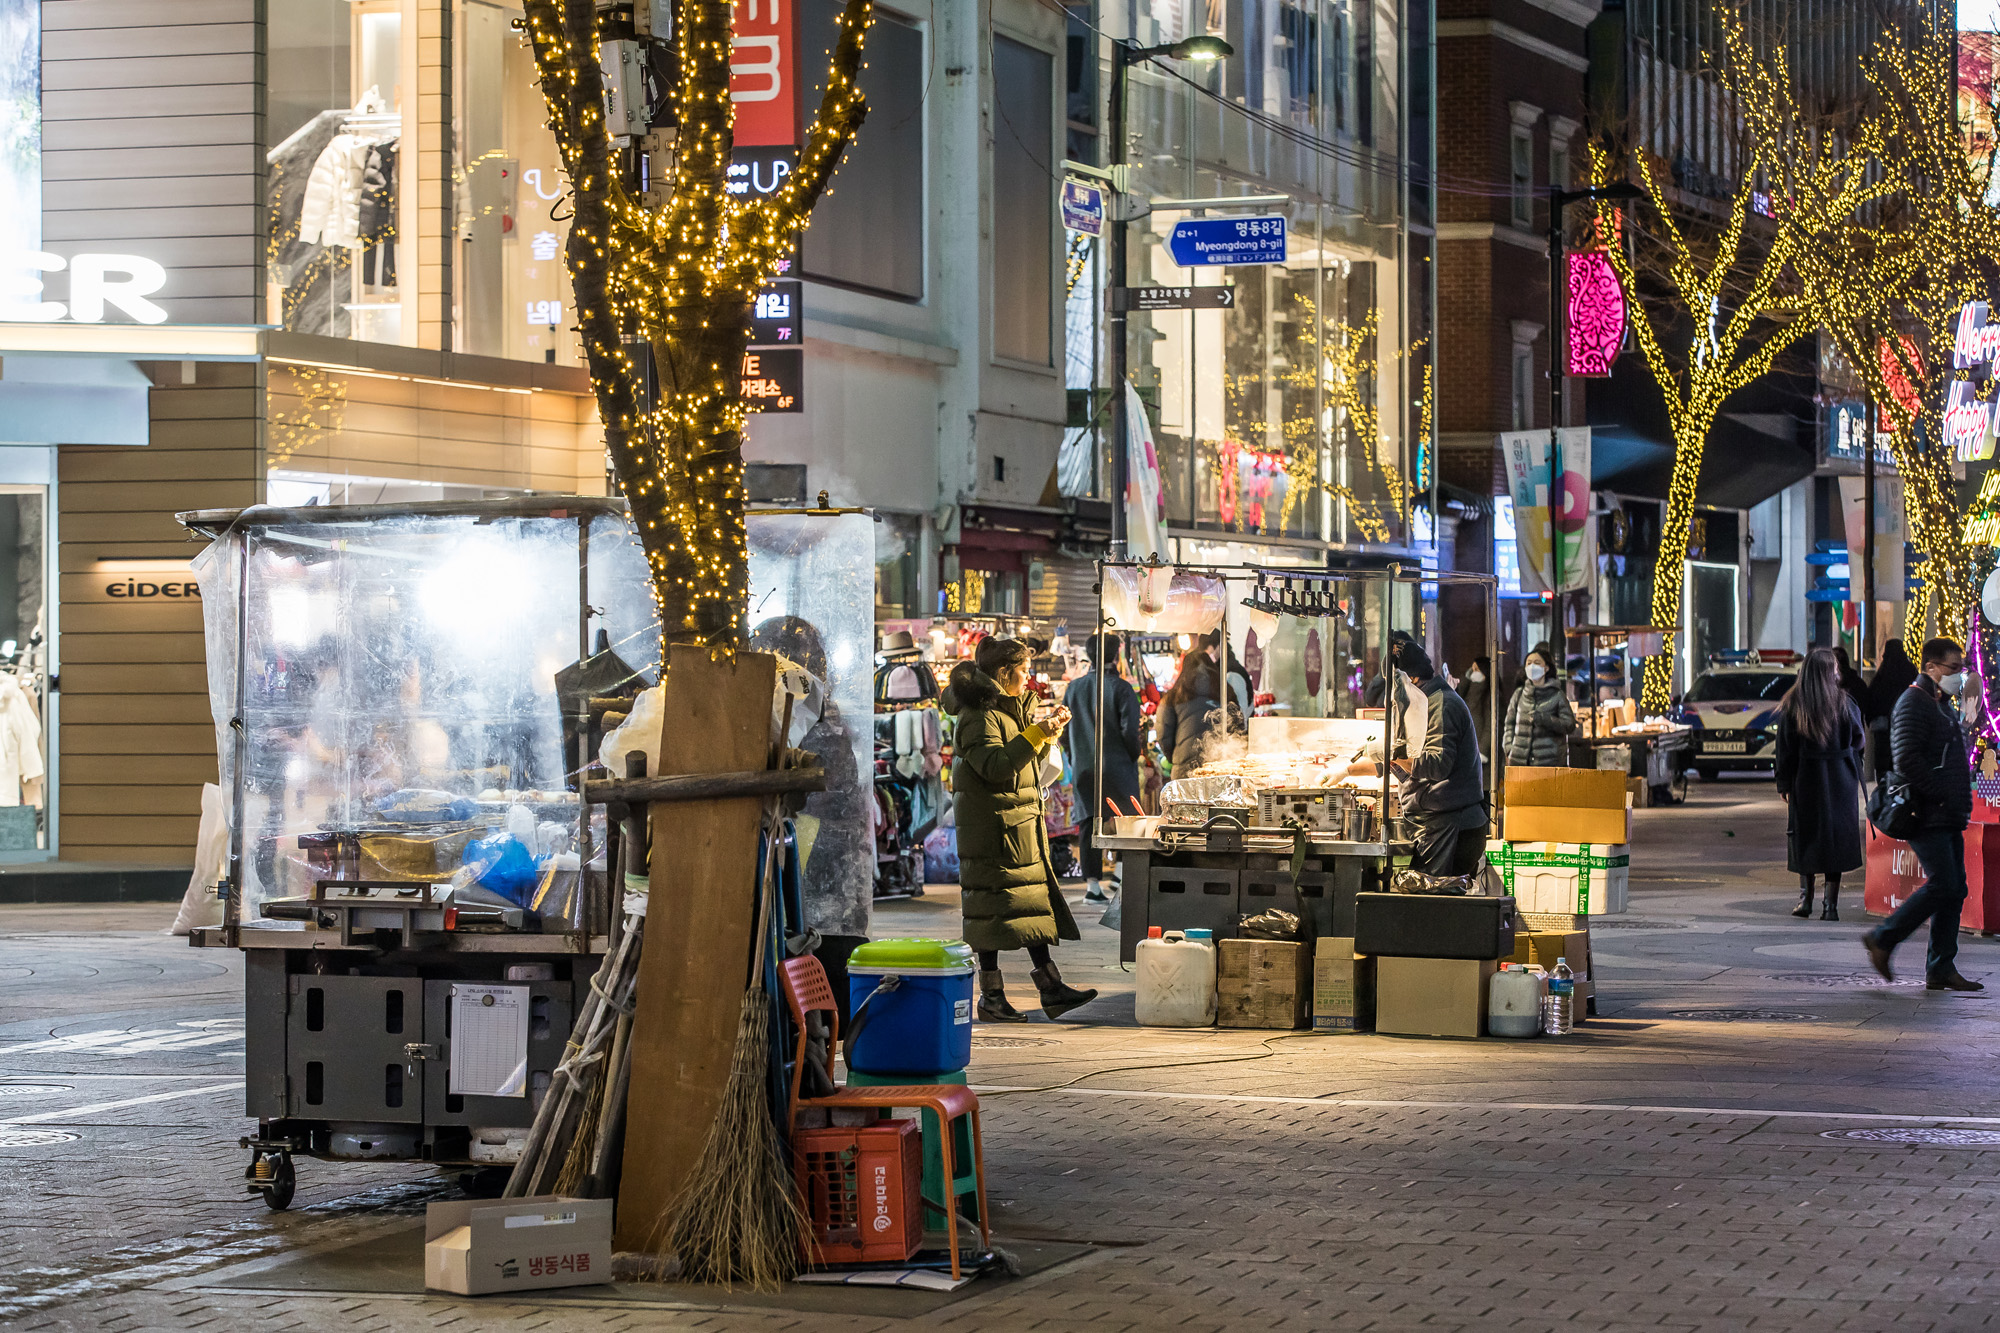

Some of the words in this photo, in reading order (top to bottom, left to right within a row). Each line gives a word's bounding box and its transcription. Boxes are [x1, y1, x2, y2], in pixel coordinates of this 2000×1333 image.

[752, 160, 790, 193] UP
[1235, 220, 1282, 237] 명동8길
[1195, 241, 1258, 253] Myeongdong
[1260, 239, 1282, 250] 8-gil
[777, 328, 792, 340] 7F
[777, 396, 793, 409] 6F
[1942, 380, 1990, 462] Happy
[1892, 848, 1916, 877] LIGHT
[1504, 878, 1513, 897] utlet
[875, 1166, 888, 1215] 연세대학교
[529, 1253, 590, 1277] 냉동식품
